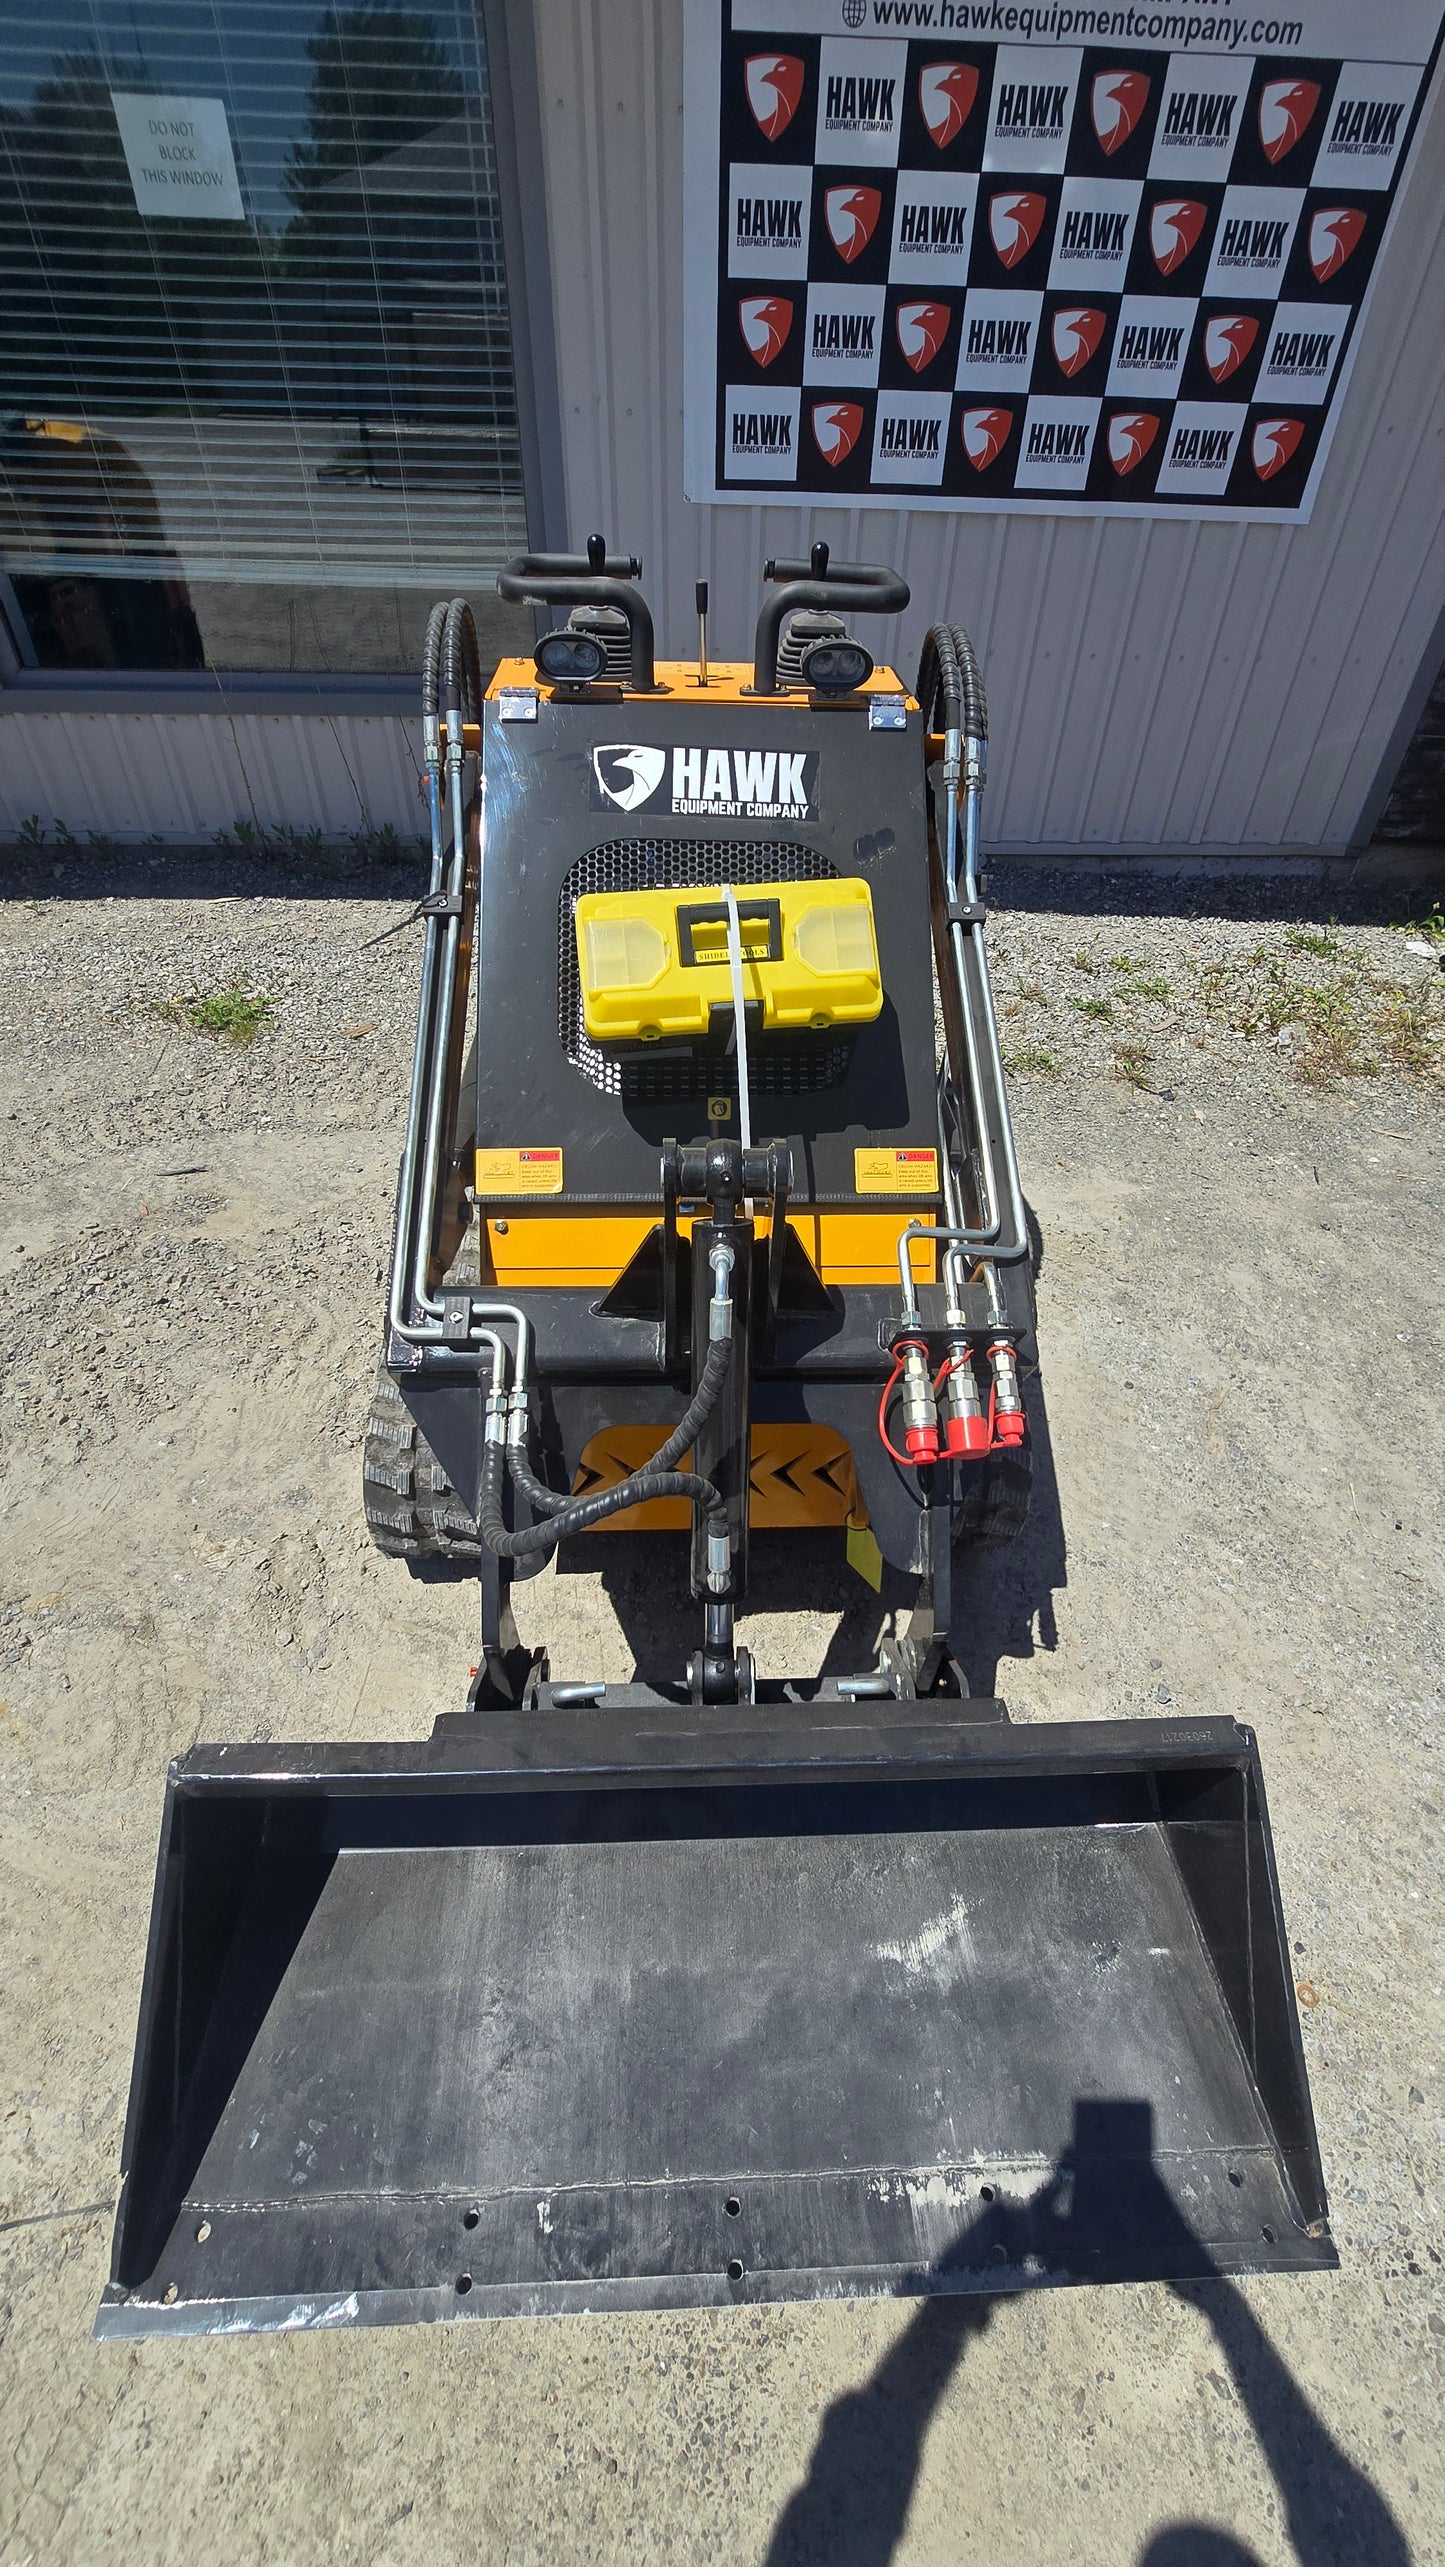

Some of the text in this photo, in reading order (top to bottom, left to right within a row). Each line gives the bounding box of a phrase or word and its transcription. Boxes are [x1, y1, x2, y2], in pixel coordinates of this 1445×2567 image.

[873, 0, 1303, 50] www.hawkequipmentcompany.com
[826, 76, 896, 121] HAWK
[996, 84, 1068, 128] HAWK
[1164, 92, 1238, 137] HAWK
[1330, 100, 1405, 145] HAWK
[148, 120, 194, 137] DO NOT
[825, 119, 894, 132] EQUIPMENT COMPANY
[994, 126, 1063, 139] EQUIPMENT COMPANY
[1161, 134, 1229, 148] EQUIPMENT COMPANY
[1327, 142, 1393, 156] EQUIPMENT COMPANY
[158, 145, 197, 160] BLOCK
[142, 168, 223, 186] THIS WINDOW
[737, 198, 803, 238] HAWK
[901, 205, 968, 244] HAWK
[1061, 211, 1129, 250] HAWK
[1219, 219, 1289, 258] HAWK
[736, 236, 802, 249] EQUIPMENT COMPANY
[899, 242, 964, 255] EQUIPMENT COMPANY
[1059, 248, 1123, 261] EQUIPMENT COMPANY
[1217, 256, 1281, 269] EQUIPMENT COMPANY
[813, 314, 875, 350] HAWK
[967, 320, 1032, 355] HAWK
[1118, 326, 1184, 361] HAWK
[1269, 332, 1335, 368] HAWK
[812, 349, 873, 360] EQUIPMENT COMPANY
[966, 353, 1027, 365] EQUIPMENT COMPANY
[1116, 359, 1178, 371] EQUIPMENT COMPANY
[1267, 366, 1327, 377] EQUIPMENT COMPANY
[732, 413, 792, 446] HAWK
[881, 418, 942, 451] HAWK
[1027, 423, 1090, 456] HAWK
[1171, 429, 1235, 461] HAWK
[732, 445, 792, 454] EQUIPMENT COMPANY
[880, 449, 939, 459] EQUIPMENT COMPANY
[1026, 454, 1085, 464] EQUIPMENT COMPANY
[1168, 459, 1227, 469] EQUIPMENT COMPANY
[673, 748, 807, 804] HAWK
[672, 799, 809, 819] EQUIPMENT COMPANY
